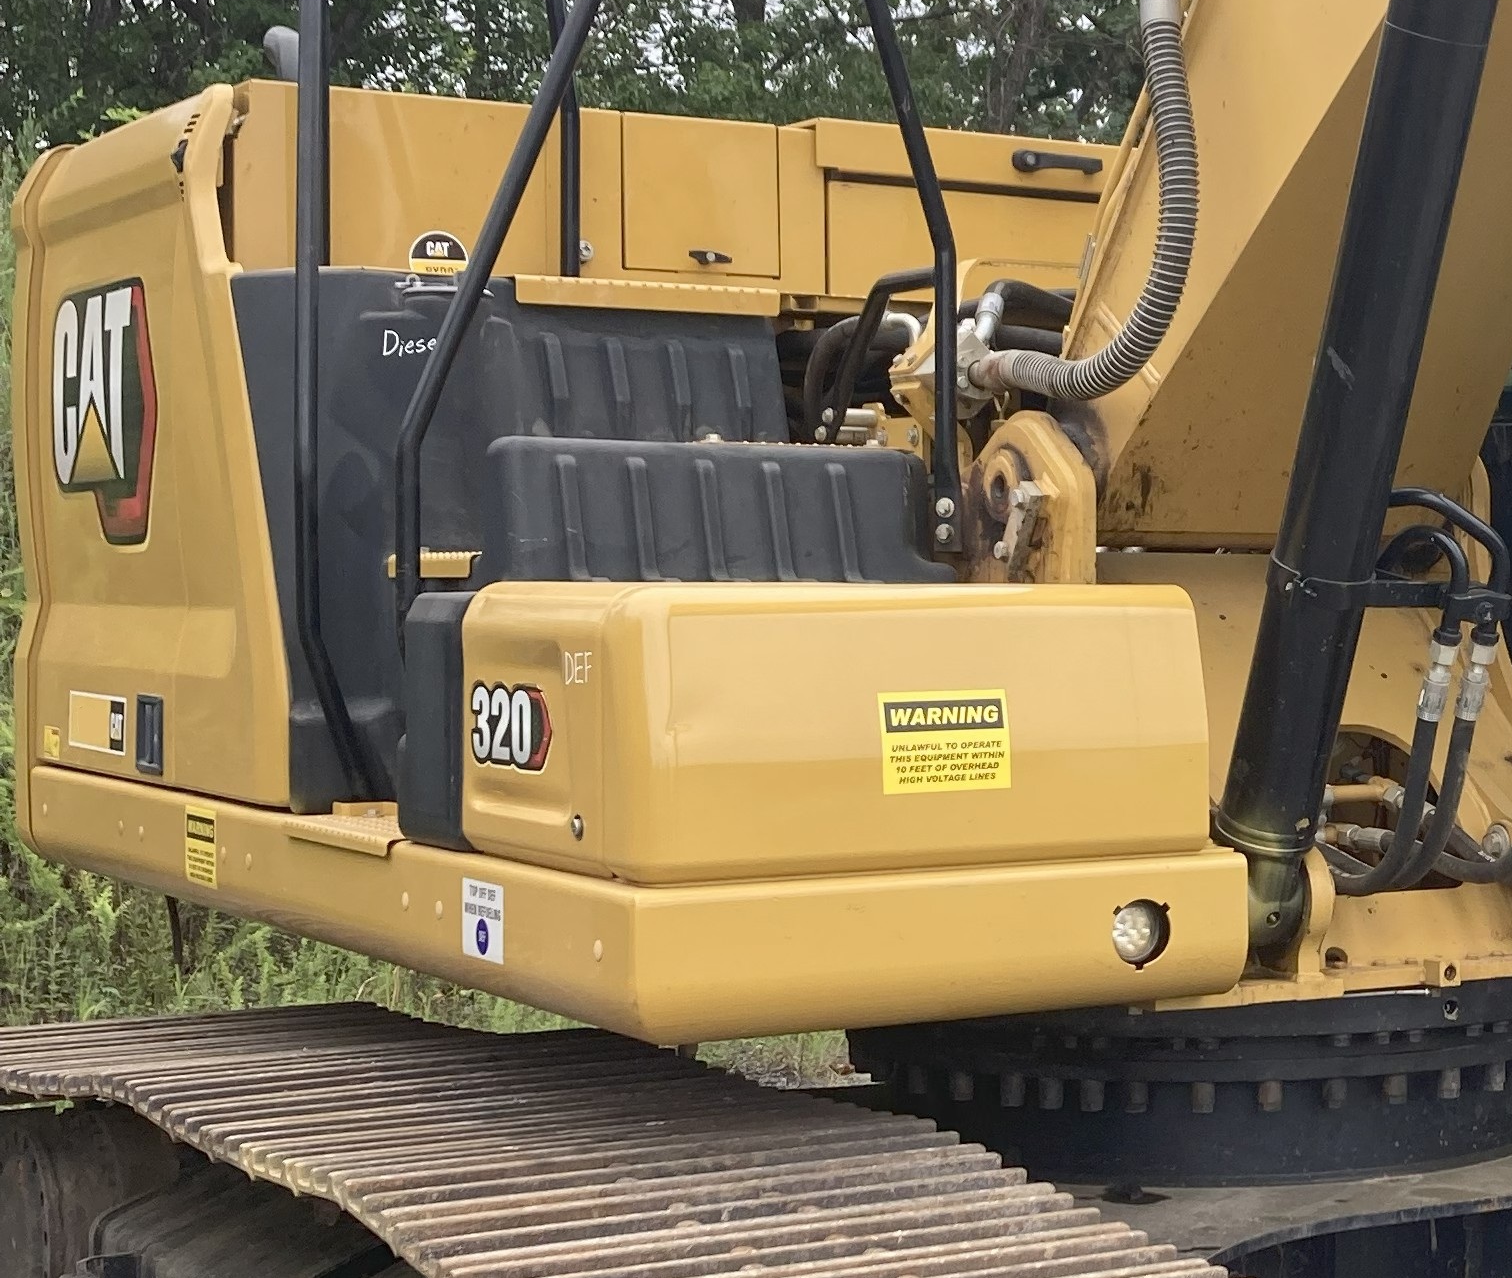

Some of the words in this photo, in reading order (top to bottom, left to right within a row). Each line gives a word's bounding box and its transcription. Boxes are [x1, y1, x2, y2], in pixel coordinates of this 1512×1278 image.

[425, 240, 450, 258] CAT
[382, 329, 437, 357] Diese
[53, 286, 133, 485] CAT
[564, 650, 593, 685] DEF
[471, 685, 532, 765] 320
[889, 704, 999, 727] WARNING
[890, 754, 912, 763] THIS
[914, 752, 970, 762] EQUIPMENT
[971, 750, 1005, 760] WITHIN
[891, 743, 942, 753] UNLAWFUL
[946, 741, 958, 750] TO
[960, 740, 1002, 750] OPERATE
[896, 765, 907, 774] 10
[909, 764, 932, 773] FEET
[934, 763, 947, 772] OF
[950, 761, 1000, 771] OVERHEAD
[898, 775, 923, 784] HIGH
[926, 773, 967, 783] VOLTAGE
[969, 772, 996, 781] LINES
